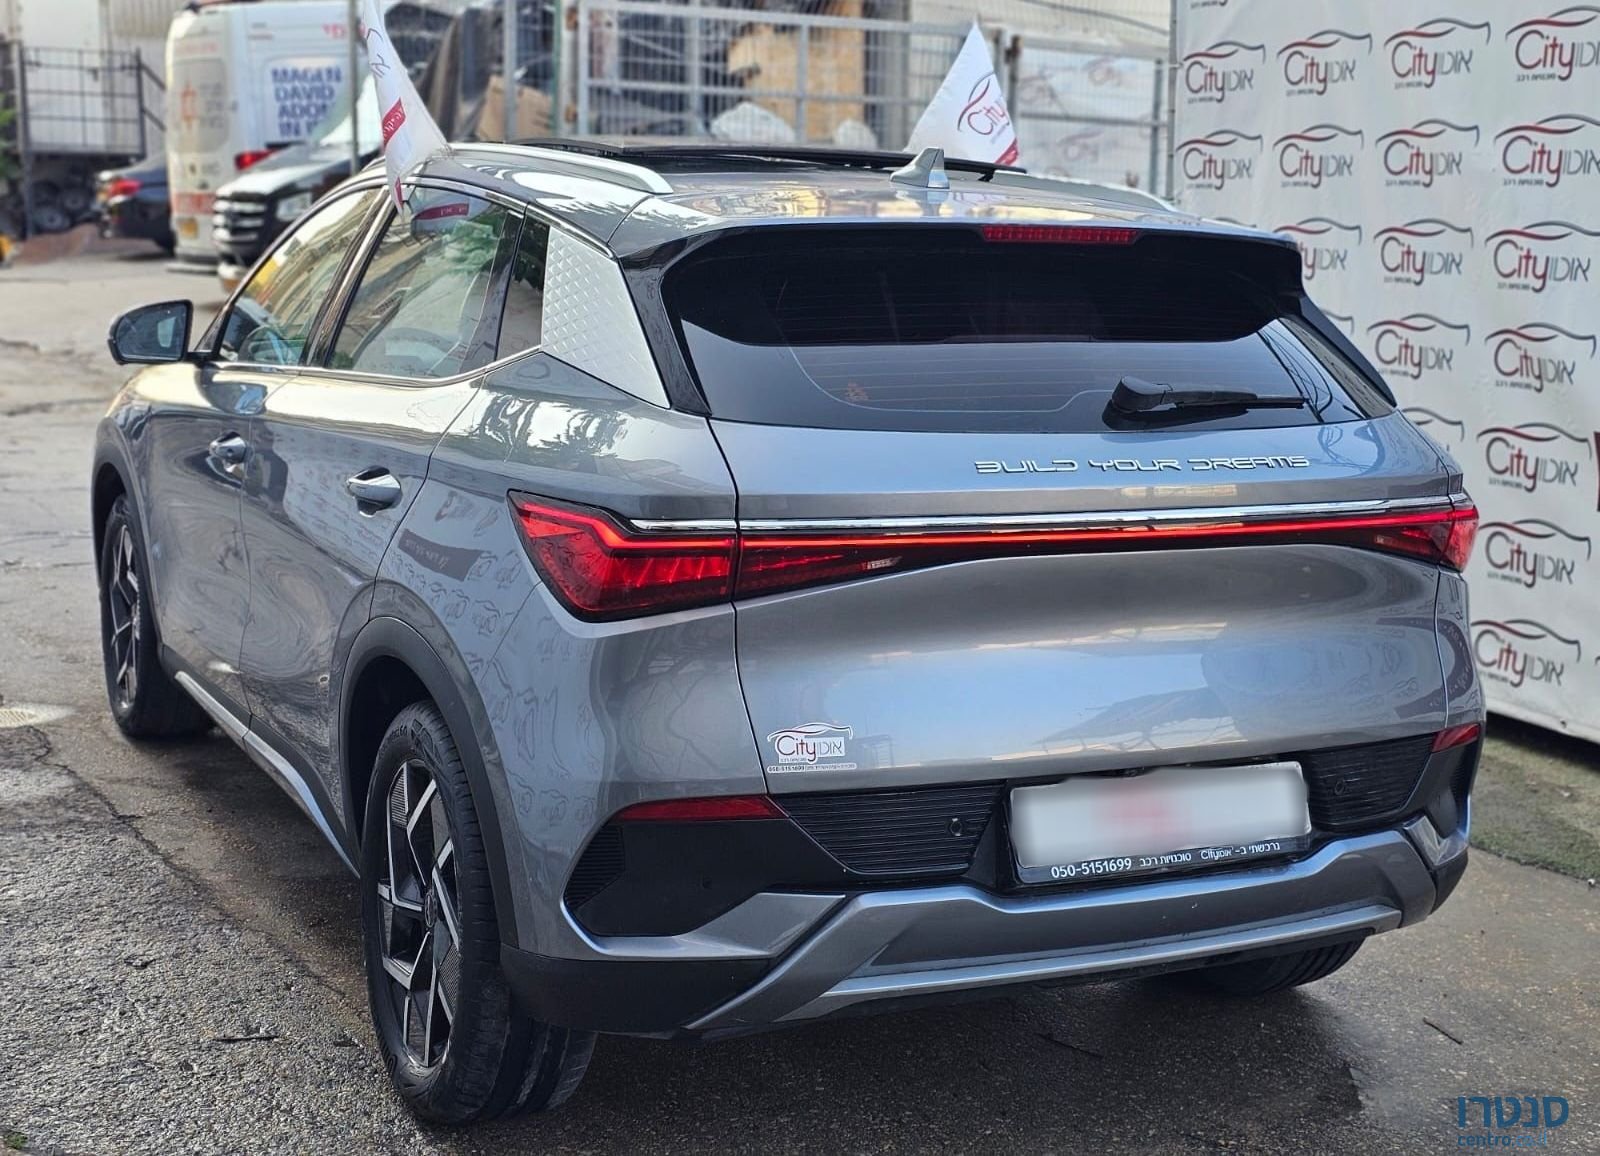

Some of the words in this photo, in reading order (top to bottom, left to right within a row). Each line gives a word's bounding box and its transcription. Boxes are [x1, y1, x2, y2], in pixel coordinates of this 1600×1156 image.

[1284, 50, 1327, 96] City
[1391, 40, 1437, 88] City
[1515, 29, 1576, 81] City
[275, 86, 335, 102] DAVID
[1185, 60, 1225, 103] City
[1183, 147, 1225, 191] City
[1279, 142, 1323, 189] City
[1384, 138, 1434, 188] City
[1502, 134, 1563, 188] City
[1381, 236, 1426, 286] City
[1493, 238, 1550, 293] City
[1375, 328, 1423, 380] City
[1494, 337, 1544, 394] City
[975, 459, 1079, 473] BUILD
[1088, 458, 1182, 472] YOUR
[1187, 455, 1310, 472] DREAMS
[1486, 436, 1540, 493] City
[1485, 531, 1538, 589] City
[1474, 629, 1528, 688] City
[776, 735, 817, 762] City
[1051, 857, 1132, 878] 050-5151699
[1140, 856, 1158, 867] רכב
[1249, 842, 1280, 853] נרכשתי
